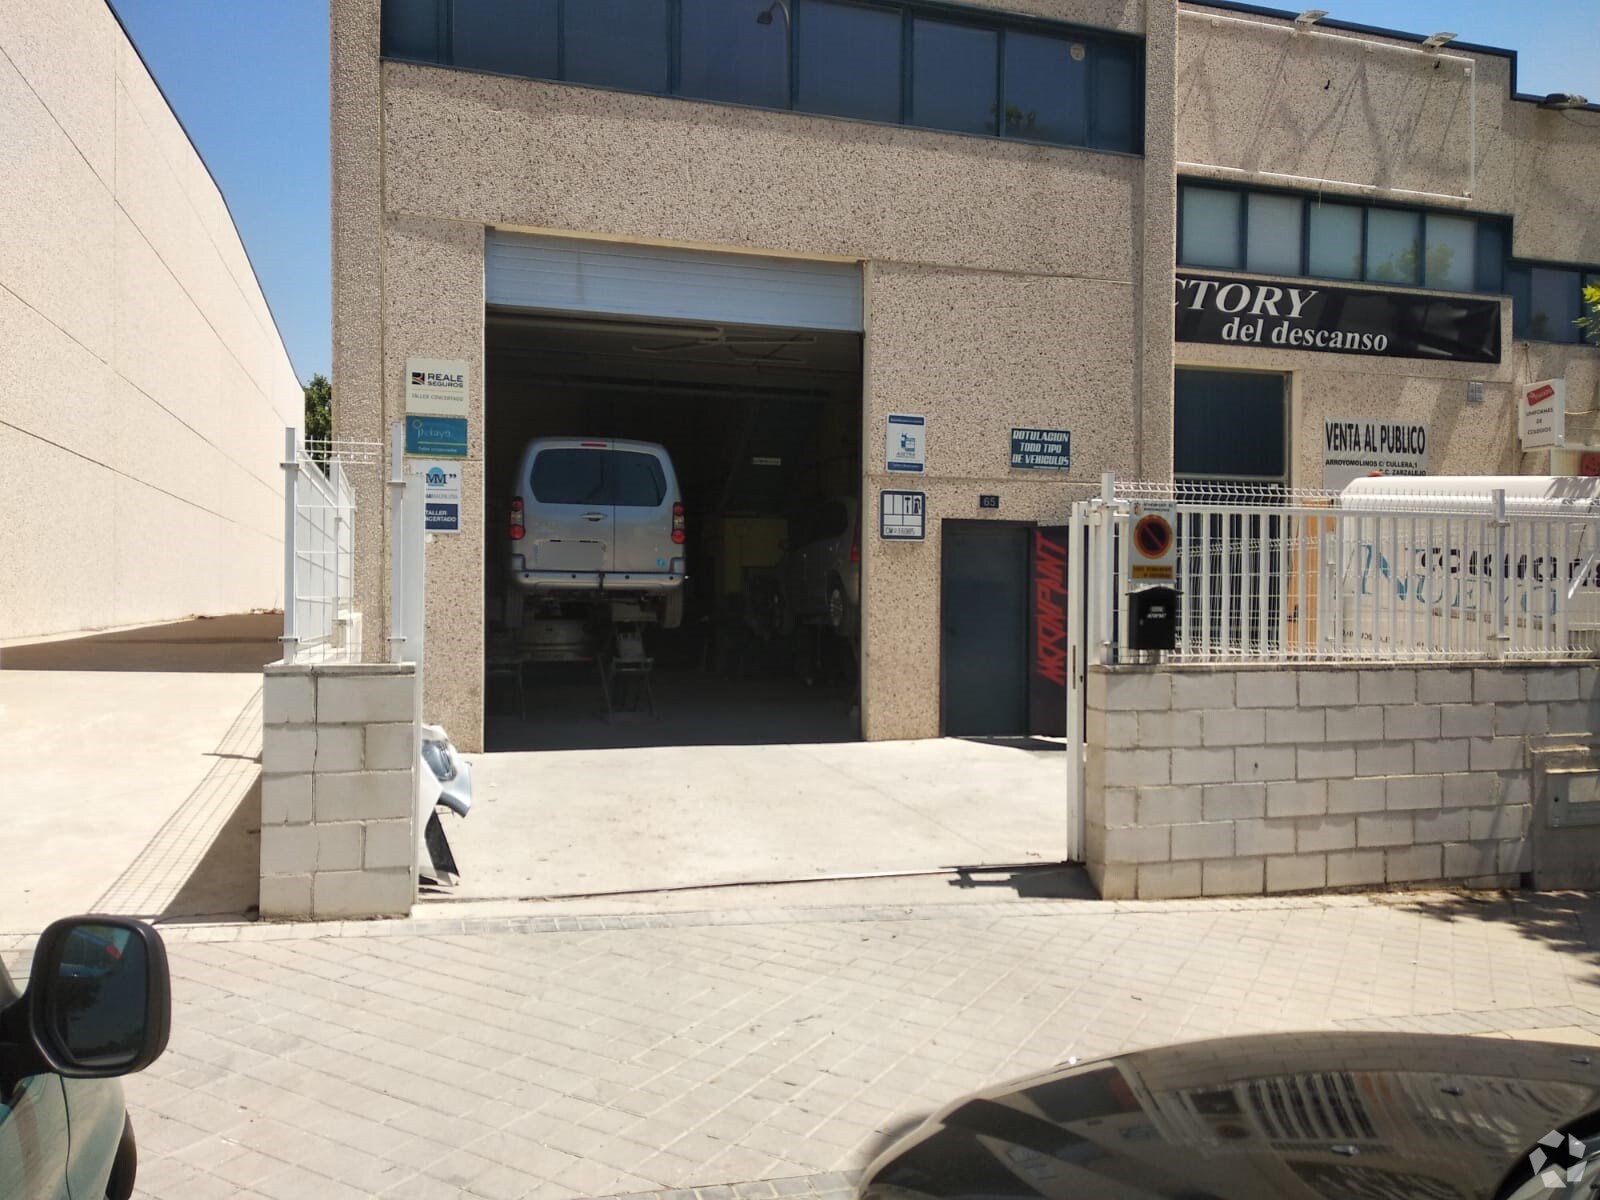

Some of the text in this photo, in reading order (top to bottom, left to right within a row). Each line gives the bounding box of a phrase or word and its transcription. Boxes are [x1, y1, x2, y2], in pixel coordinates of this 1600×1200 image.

[1222, 317, 1388, 351] del descanso
[427, 373, 464, 382] REALE
[1012, 430, 1070, 442] ROTULACION
[1325, 423, 1426, 455] VENTA AL PUBLICO
[1020, 442, 1062, 453] TODO TIPO
[1012, 453, 1069, 466] DE VEHICULOS
[1325, 459, 1378, 467] ARROYOMOLINOS
[983, 499, 996, 507] 65
